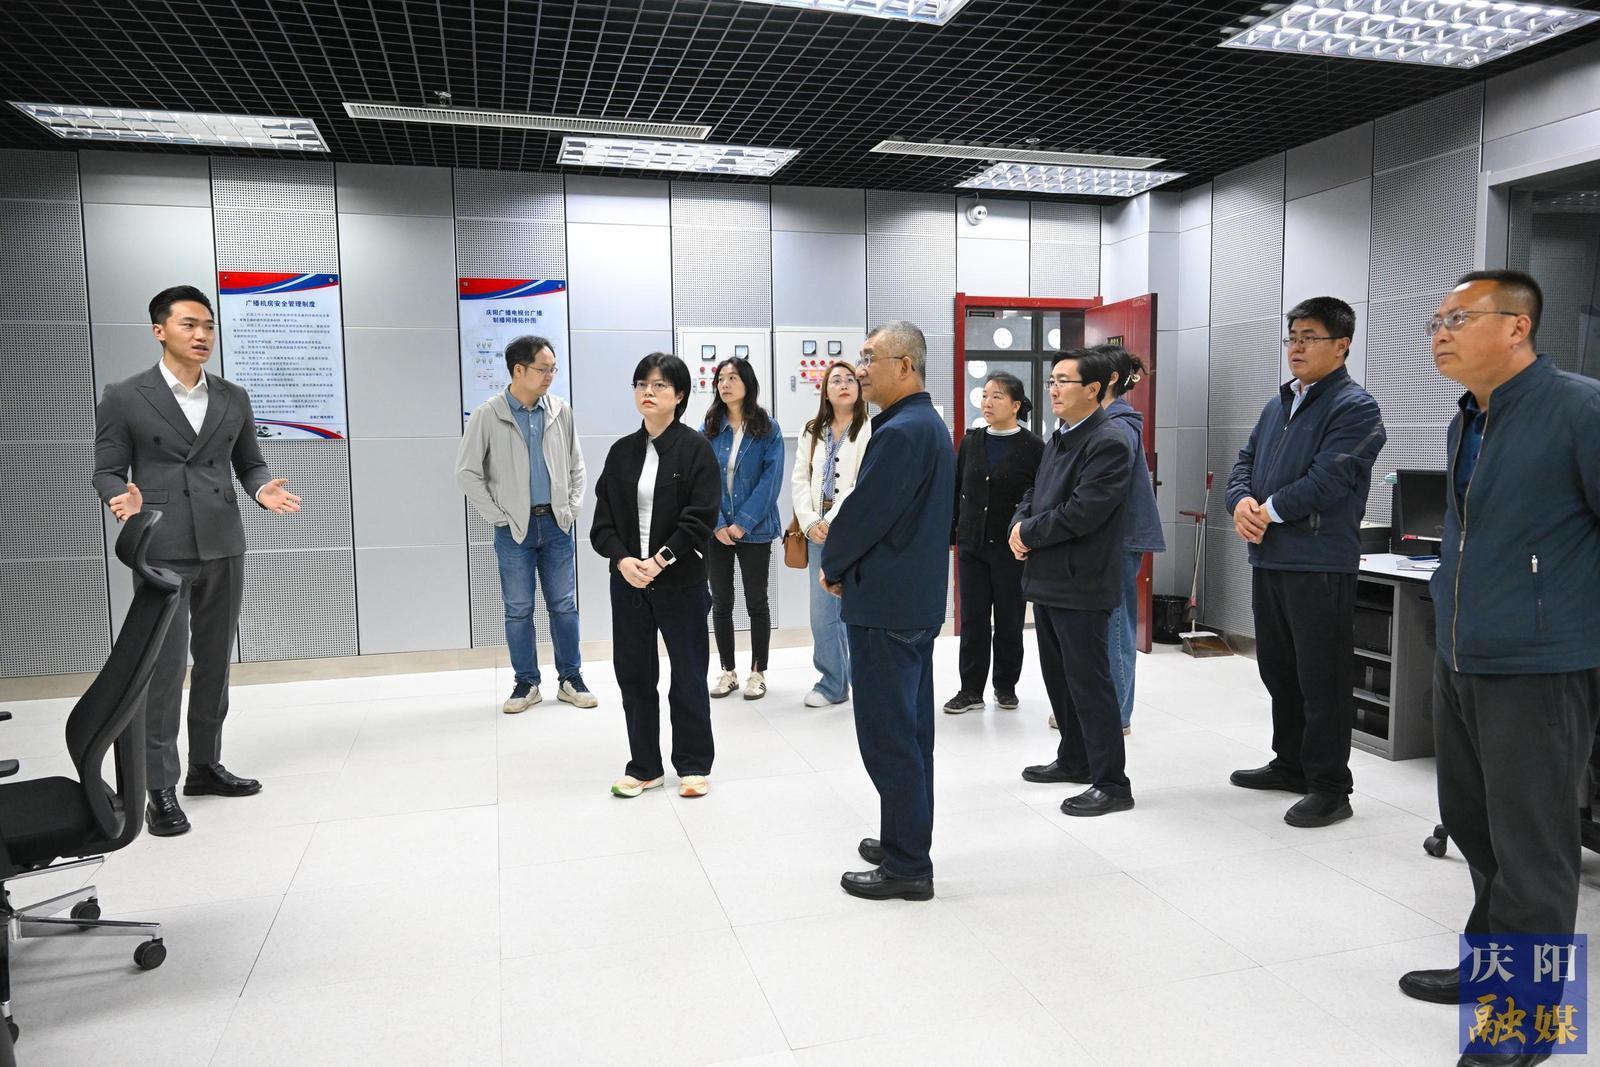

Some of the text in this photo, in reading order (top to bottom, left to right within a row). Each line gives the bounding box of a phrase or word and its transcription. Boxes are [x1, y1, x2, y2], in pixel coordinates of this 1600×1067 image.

[245, 300, 316, 308] 广播机房安全管理制度
[486, 309, 543, 317] 庆阳广播电视台广播
